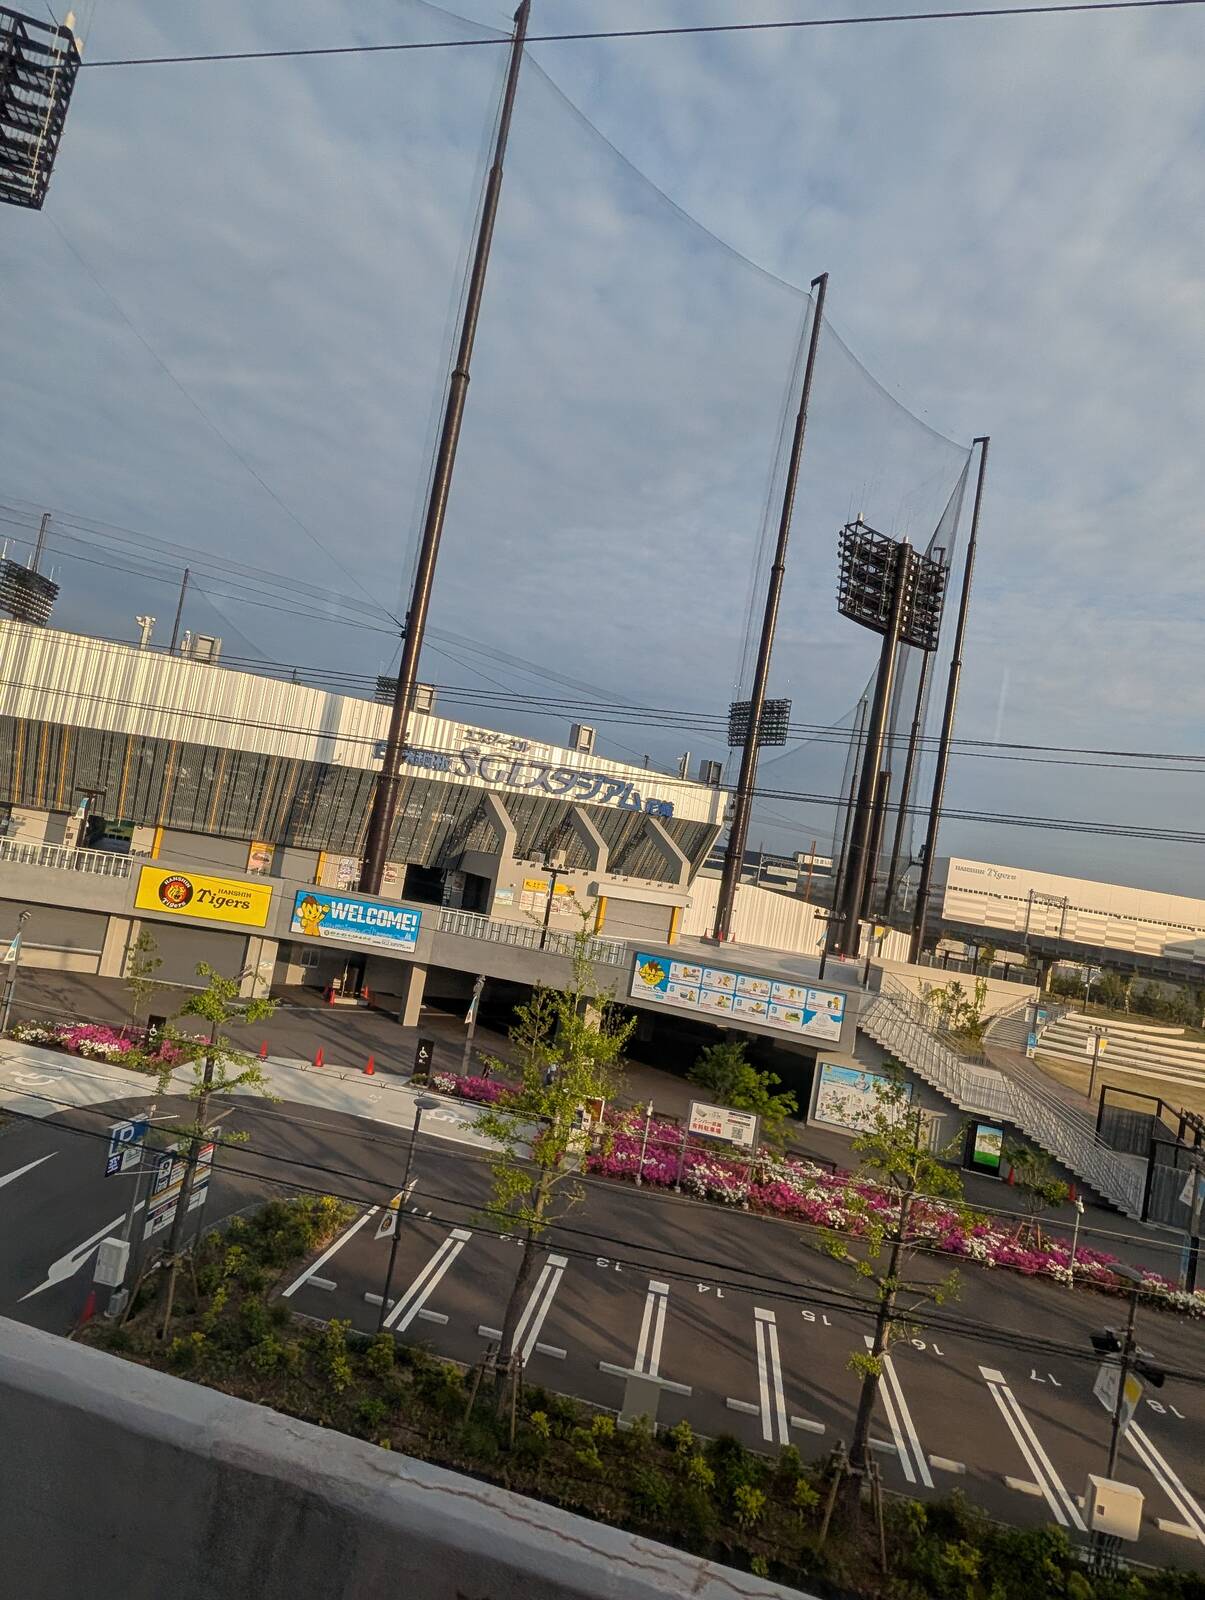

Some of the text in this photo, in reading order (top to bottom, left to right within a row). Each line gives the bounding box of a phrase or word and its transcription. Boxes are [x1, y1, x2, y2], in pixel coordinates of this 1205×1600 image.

[164, 876, 191, 888] HANSHIN
[197, 888, 251, 909] Tigers
[218, 888, 252, 898] HANSHIN
[161, 897, 186, 908] Tigers
[331, 901, 417, 932] WELCOME!
[596, 1257, 622, 1271] 13
[696, 1283, 725, 1298] 14
[801, 1310, 832, 1326] 15
[911, 1338, 945, 1356] 16
[1029, 1369, 1062, 1387] 17
[1145, 1399, 1186, 1419] 18
